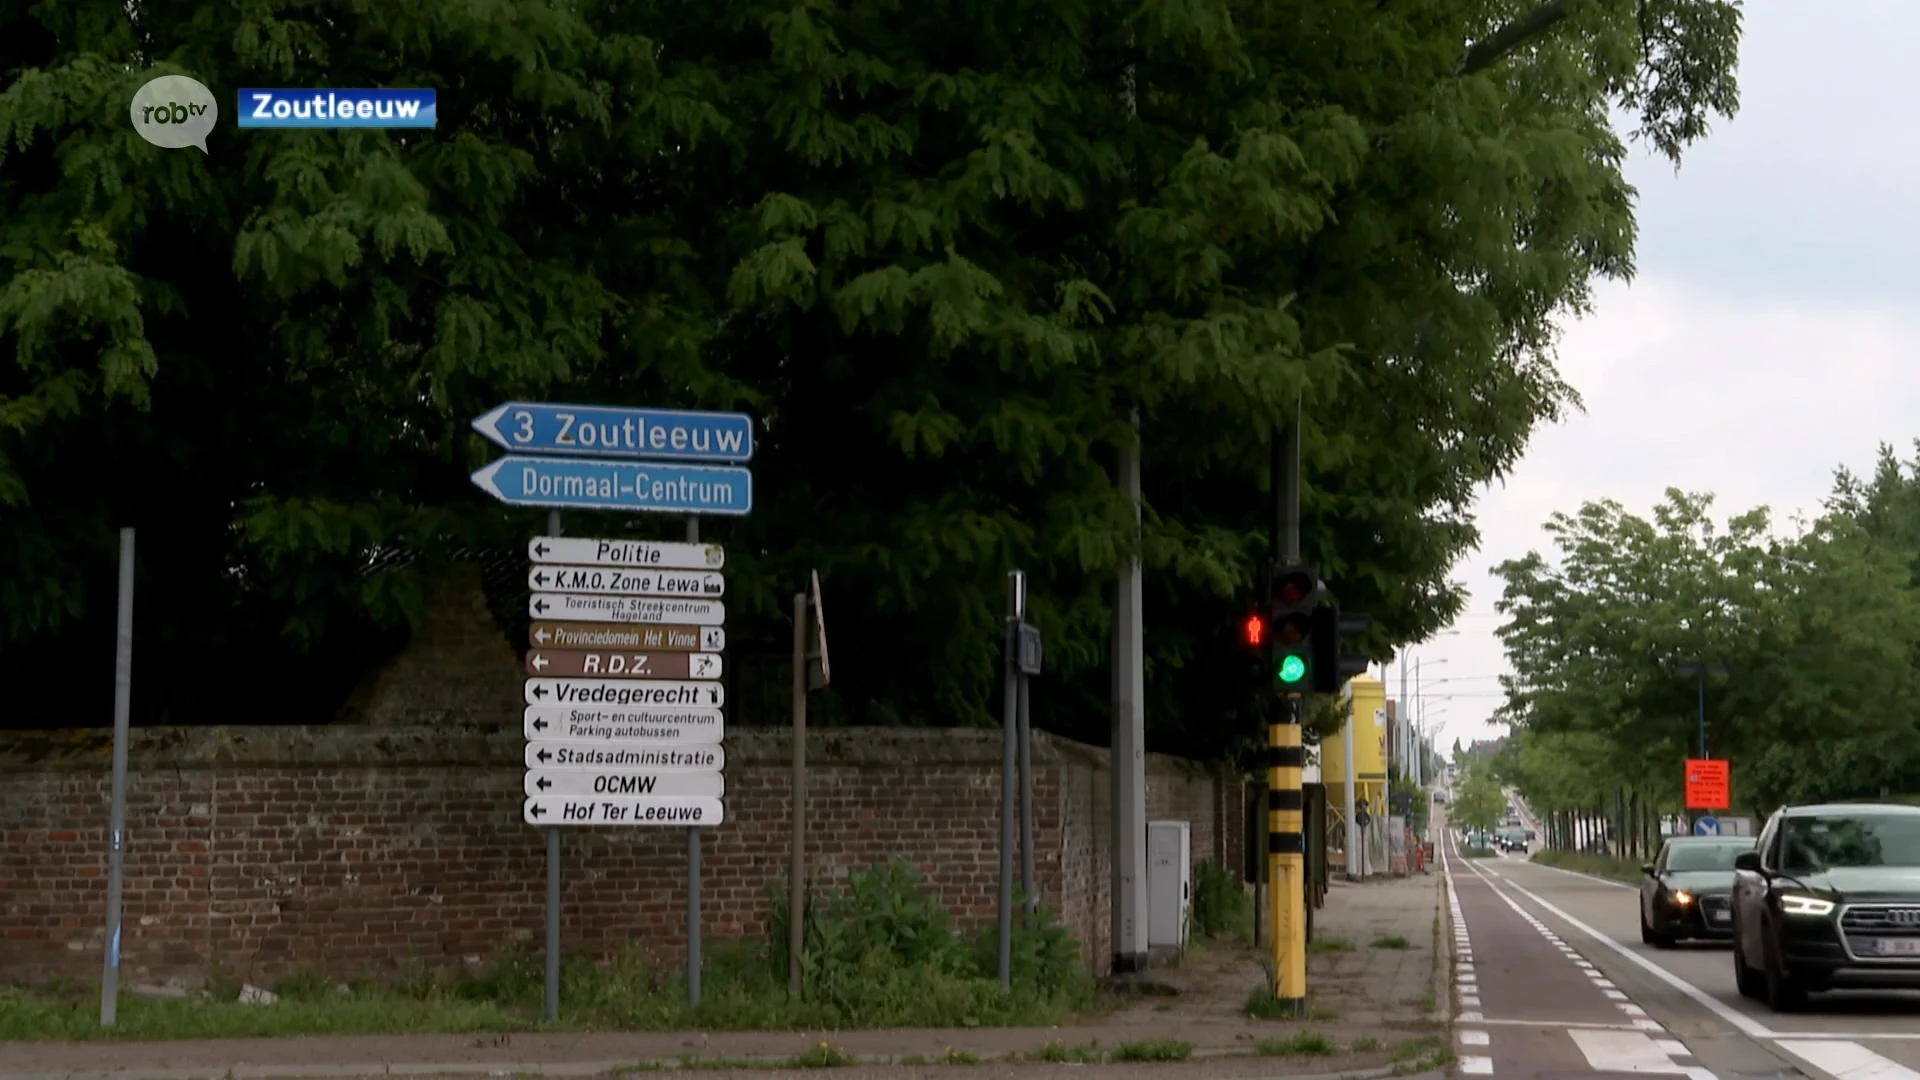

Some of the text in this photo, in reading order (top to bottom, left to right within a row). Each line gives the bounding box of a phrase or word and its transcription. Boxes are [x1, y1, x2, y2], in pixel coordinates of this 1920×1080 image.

[513, 411, 743, 452] 3 Zoutleeuw
[522, 468, 732, 504] Dormaal-Centrum
[597, 543, 660, 563] Politie
[555, 571, 699, 592] K.M.O. Zone Lewa
[565, 597, 710, 614] Toeristisch Streekcentrum
[611, 610, 662, 623] Hageland
[554, 628, 696, 648] Provinciedomein Het Vinne
[583, 654, 652, 674] R.D.Z.
[556, 683, 699, 705] Vredegerecht
[569, 710, 715, 725] Sport- en cultuurcentrum
[569, 725, 679, 740] Parking autobussen
[556, 748, 714, 766] Stadsadministratie
[594, 775, 657, 793] OCMW
[563, 802, 703, 820] Hof Ter Leeuwe
